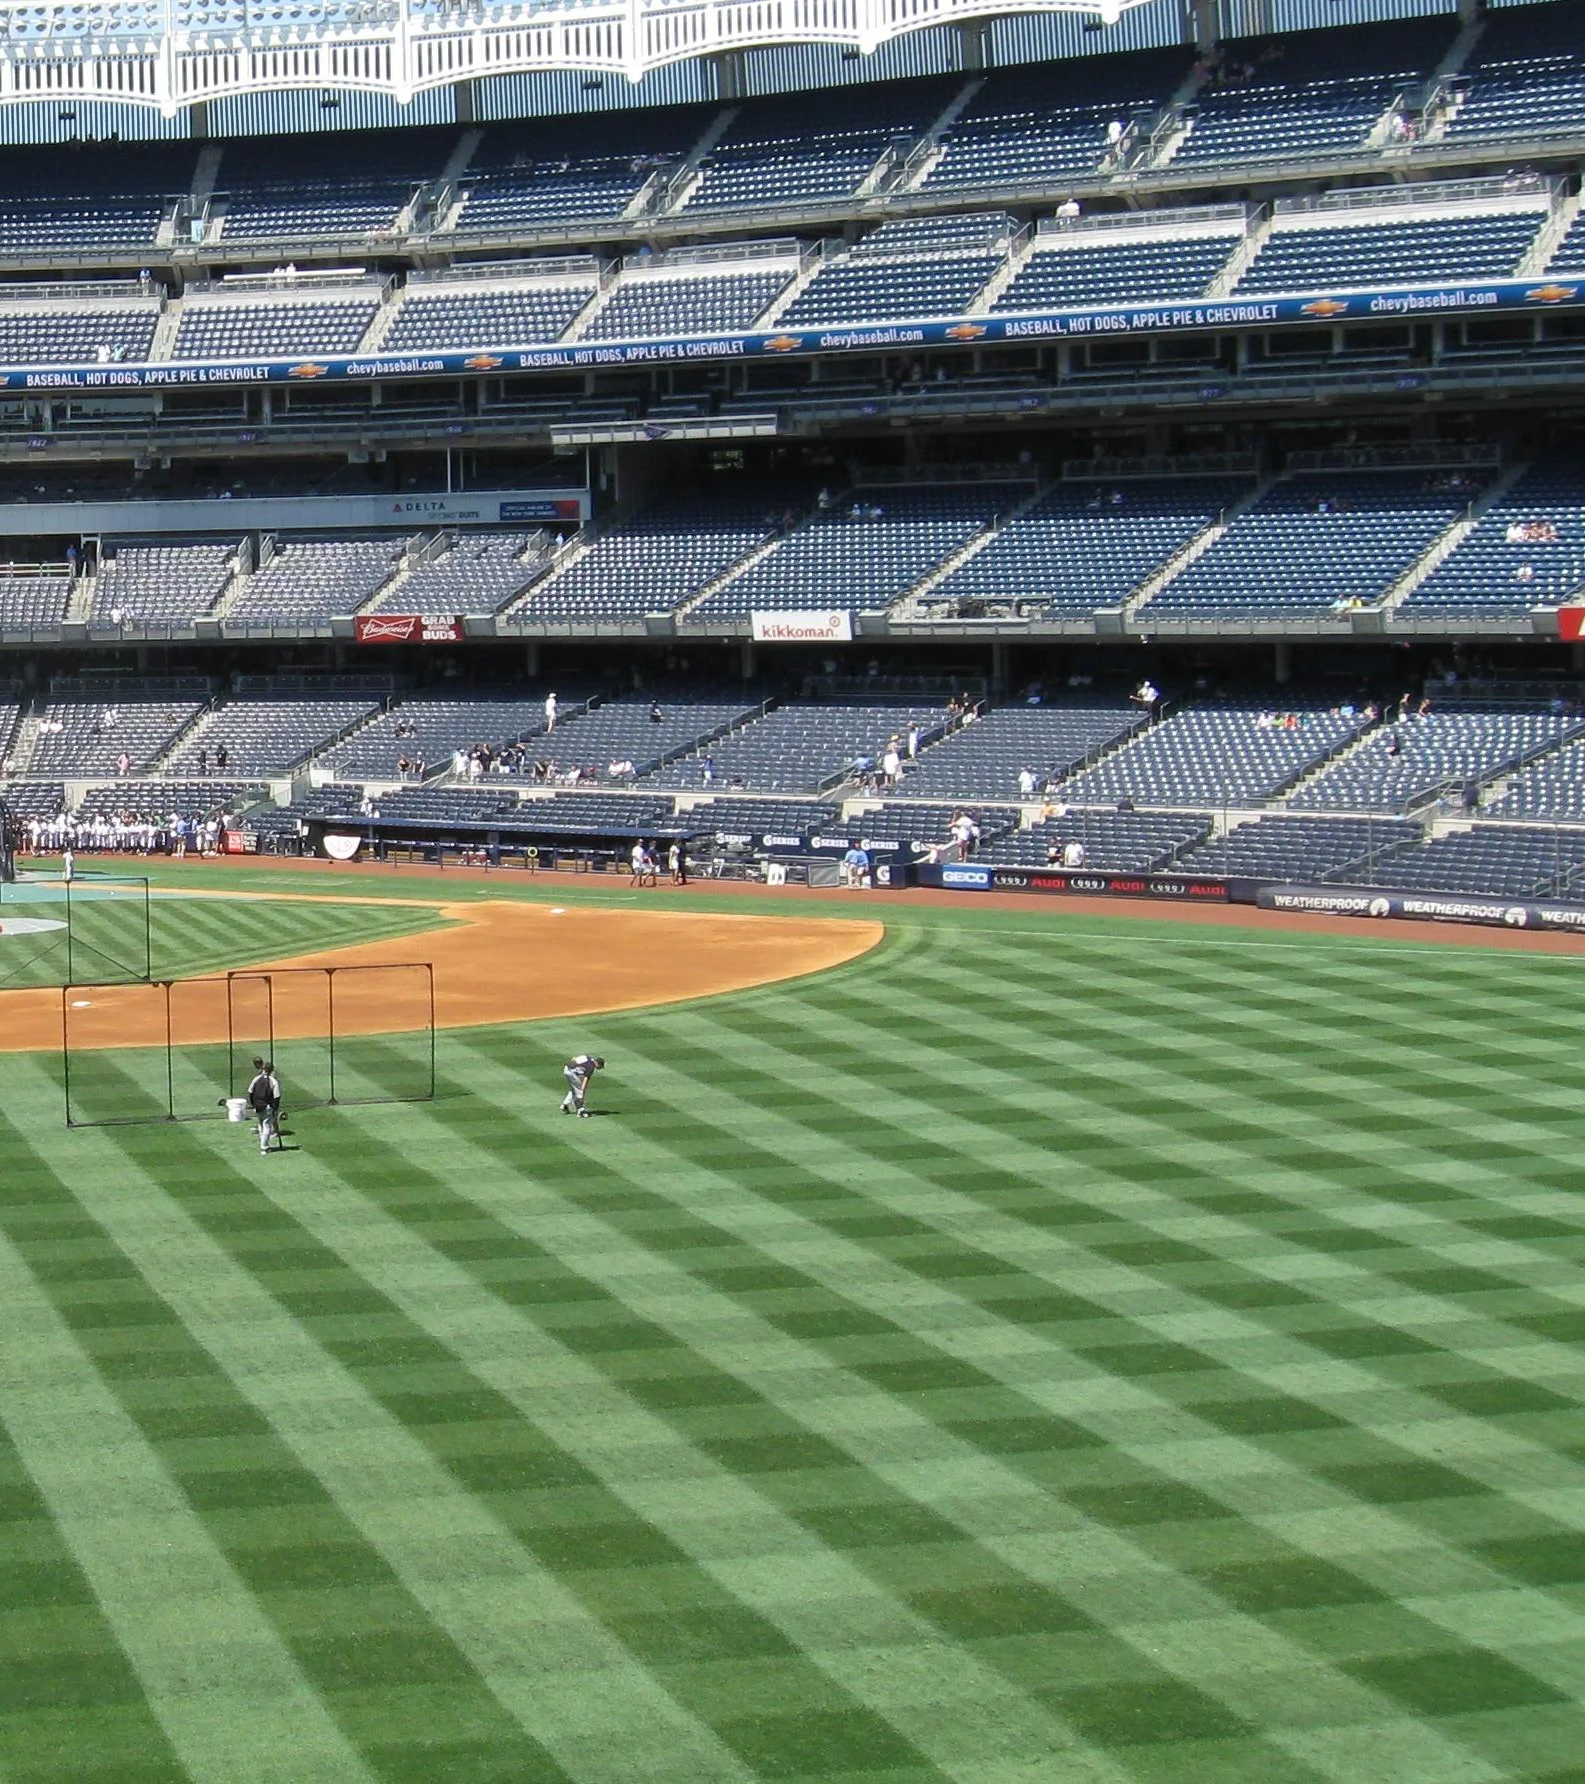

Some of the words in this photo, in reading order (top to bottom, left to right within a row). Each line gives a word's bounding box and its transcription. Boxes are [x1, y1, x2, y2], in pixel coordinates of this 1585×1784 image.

[1371, 291, 1498, 314] chevybaseball.com
[1006, 318, 1067, 338] BASEBALL,
[1069, 316, 1092, 332] HOT
[1095, 315, 1130, 332] DOGS,
[1132, 312, 1170, 329] APPLE
[1172, 311, 1193, 325] PIE
[1195, 309, 1204, 324] &
[1207, 305, 1278, 323] CHEVROLET
[821, 328, 923, 349] chevybaseball.com
[520, 350, 574, 367] BASEBALL,
[575, 349, 593, 363] HOT
[596, 348, 625, 363] DOGS,
[626, 346, 658, 362] APPLE
[659, 345, 675, 359] PIE
[677, 345, 685, 358] &
[687, 340, 745, 357] CHEVROLET
[347, 360, 440, 378] chevybaseball.com
[26, 373, 84, 388] BASEBALL,
[86, 372, 108, 386] HOT
[110, 371, 142, 386] DOGS,
[144, 370, 178, 384] APPLE
[180, 370, 197, 382] PIE
[199, 369, 207, 381] &
[209, 367, 270, 381] CHEVROLET
[406, 502, 445, 511] DELTA
[421, 616, 456, 625] GRAB
[364, 621, 414, 637] Budweiser
[422, 630, 457, 641] BUDS
[762, 624, 835, 638] kikkoman
[876, 866, 890, 879] G
[942, 871, 988, 884] GEICO
[1274, 895, 1370, 911] WEATHERPROOF
[1403, 900, 1505, 919] WEATHERPROOF
